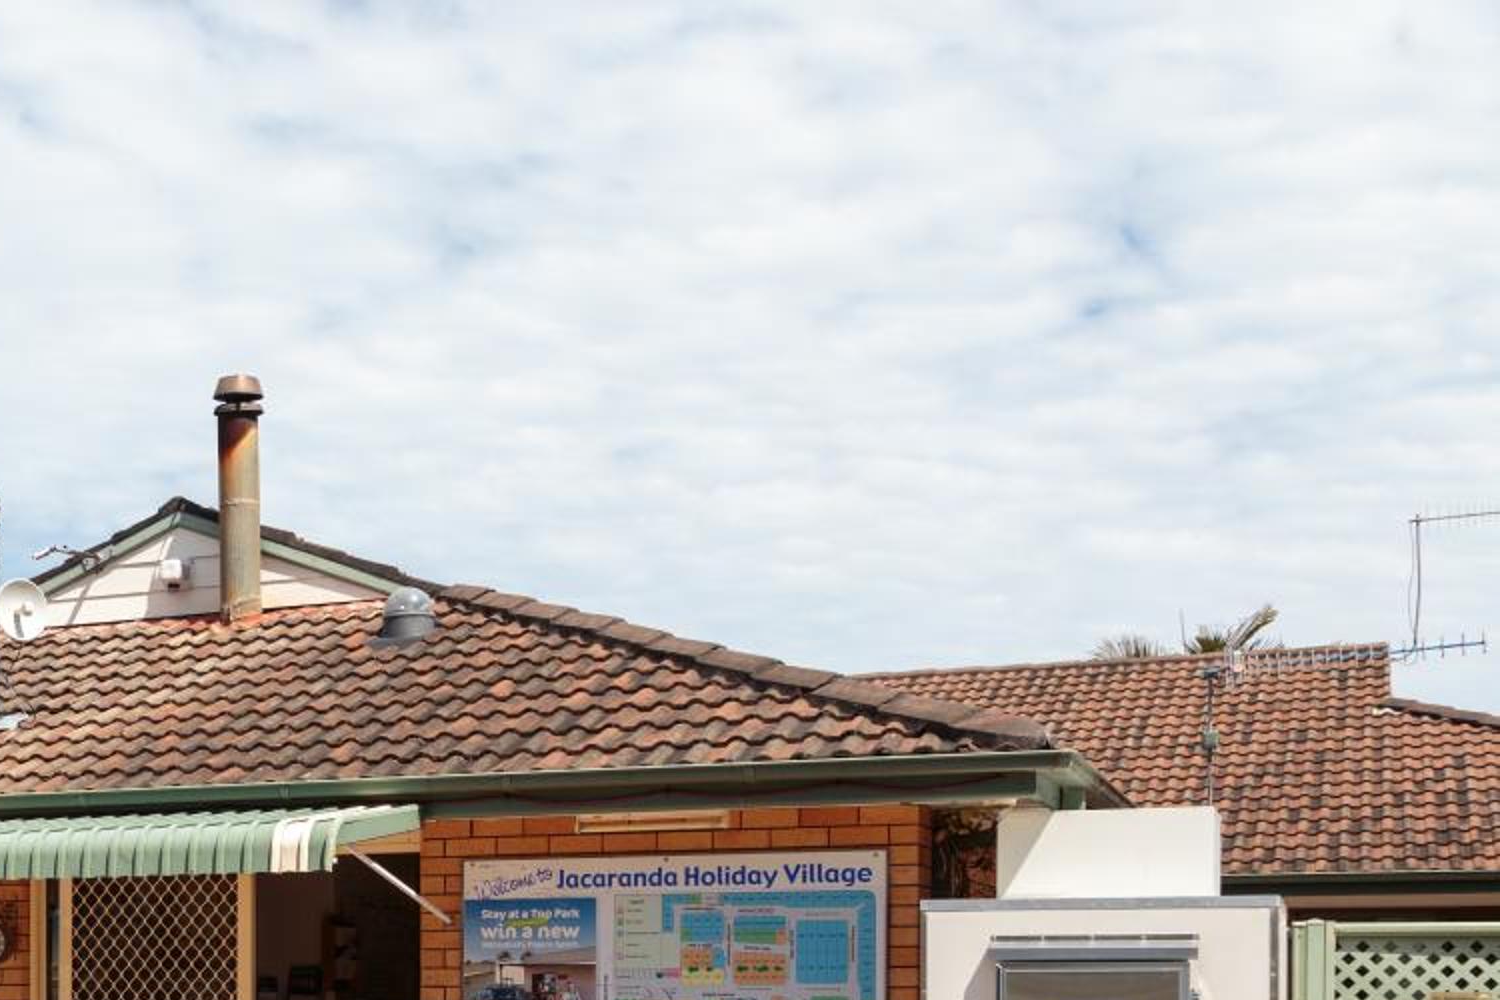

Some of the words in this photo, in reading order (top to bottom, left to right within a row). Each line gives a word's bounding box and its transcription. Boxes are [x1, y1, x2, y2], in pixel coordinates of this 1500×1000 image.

[536, 868, 553, 882] to
[557, 868, 678, 889] Jacaranda
[683, 866, 778, 888] Holiday
[783, 864, 873, 887] Village
[481, 909, 507, 922] Stay
[507, 909, 520, 919] at
[521, 910, 530, 919] a
[554, 908, 580, 919] Park
[481, 923, 517, 939] win
[521, 926, 533, 939] a
[537, 926, 581, 939] new
